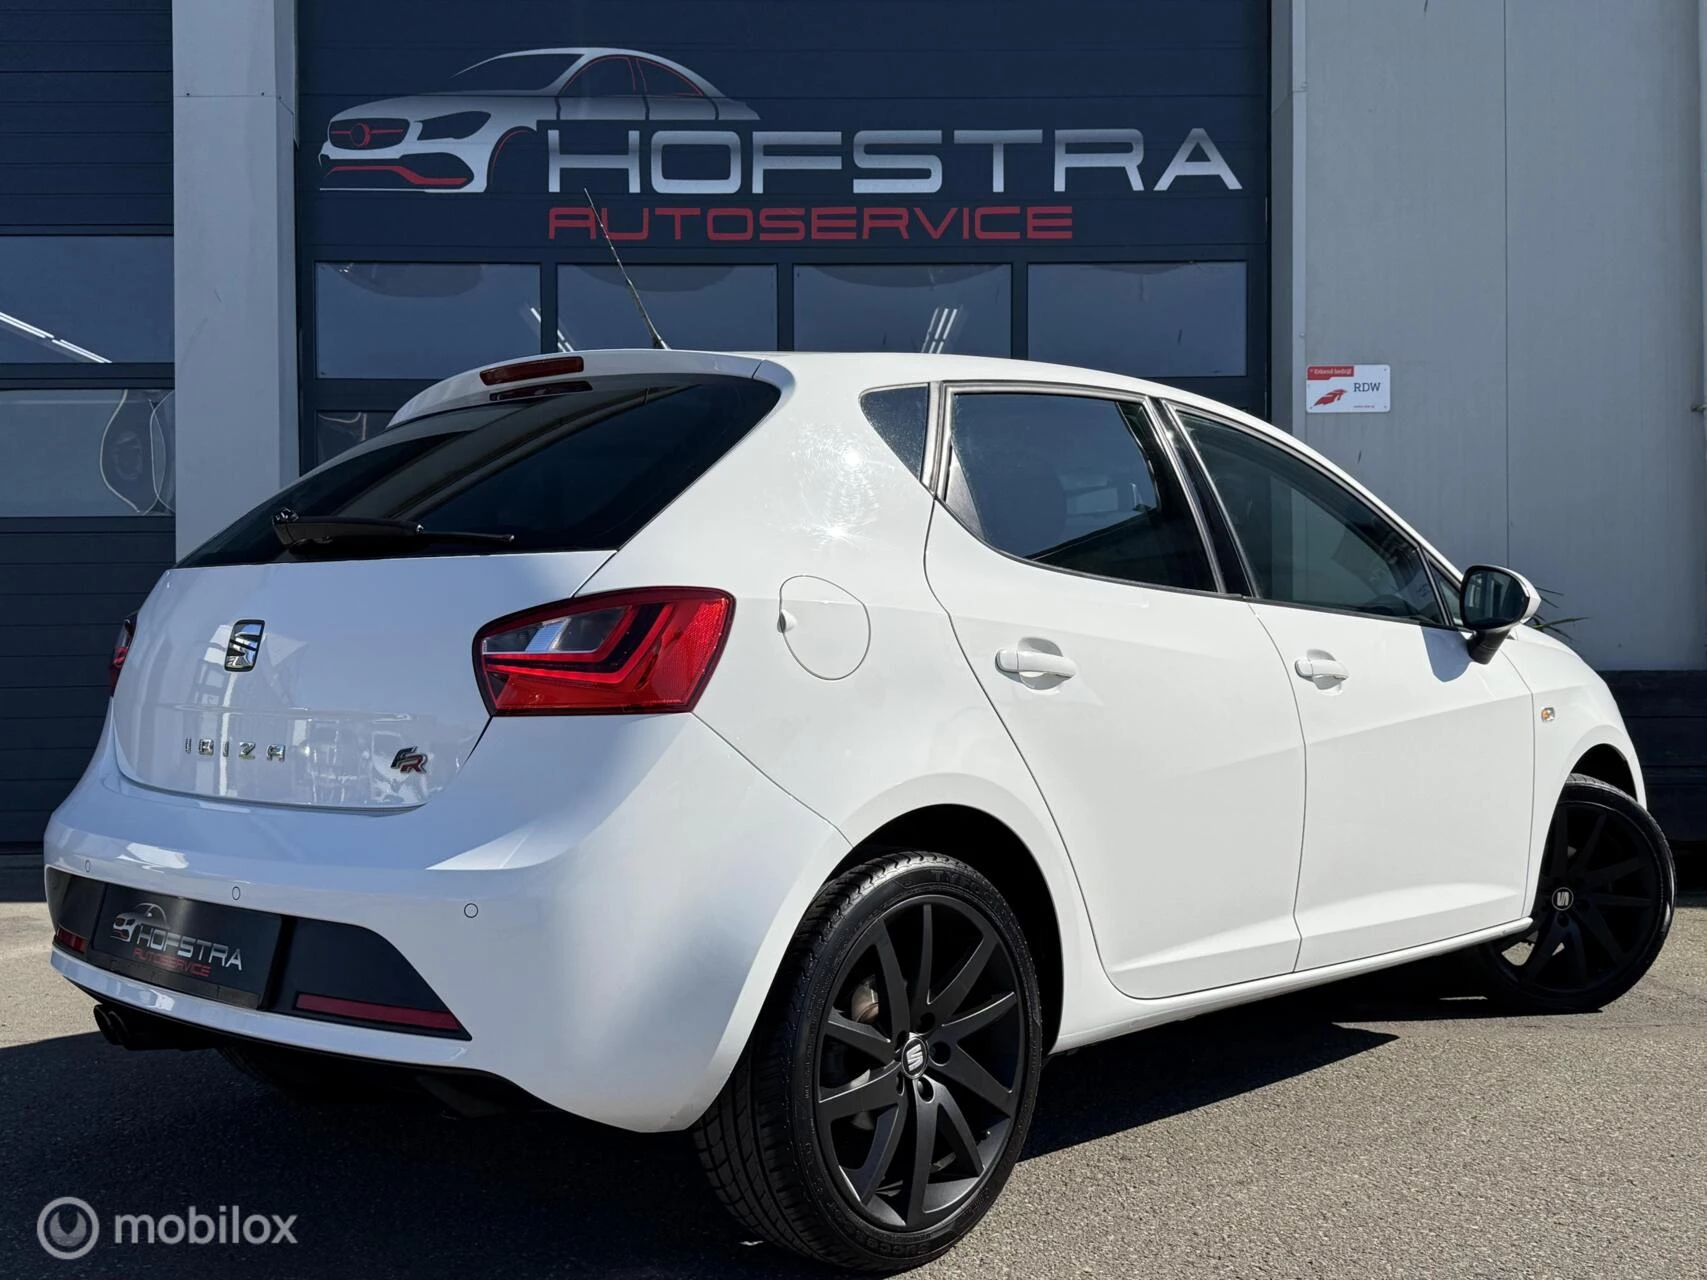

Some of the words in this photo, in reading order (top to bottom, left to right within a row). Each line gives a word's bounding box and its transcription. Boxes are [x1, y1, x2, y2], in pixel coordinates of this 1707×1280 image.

[547, 127, 1243, 195] HOFSTRA
[547, 205, 1074, 241] AUTOSERVICE
[1353, 382, 1381, 393] RDW
[184, 737, 287, 763] IBIZA
[133, 949, 212, 978] AUTOSERVICE
[136, 926, 243, 972] HOFSTRA
